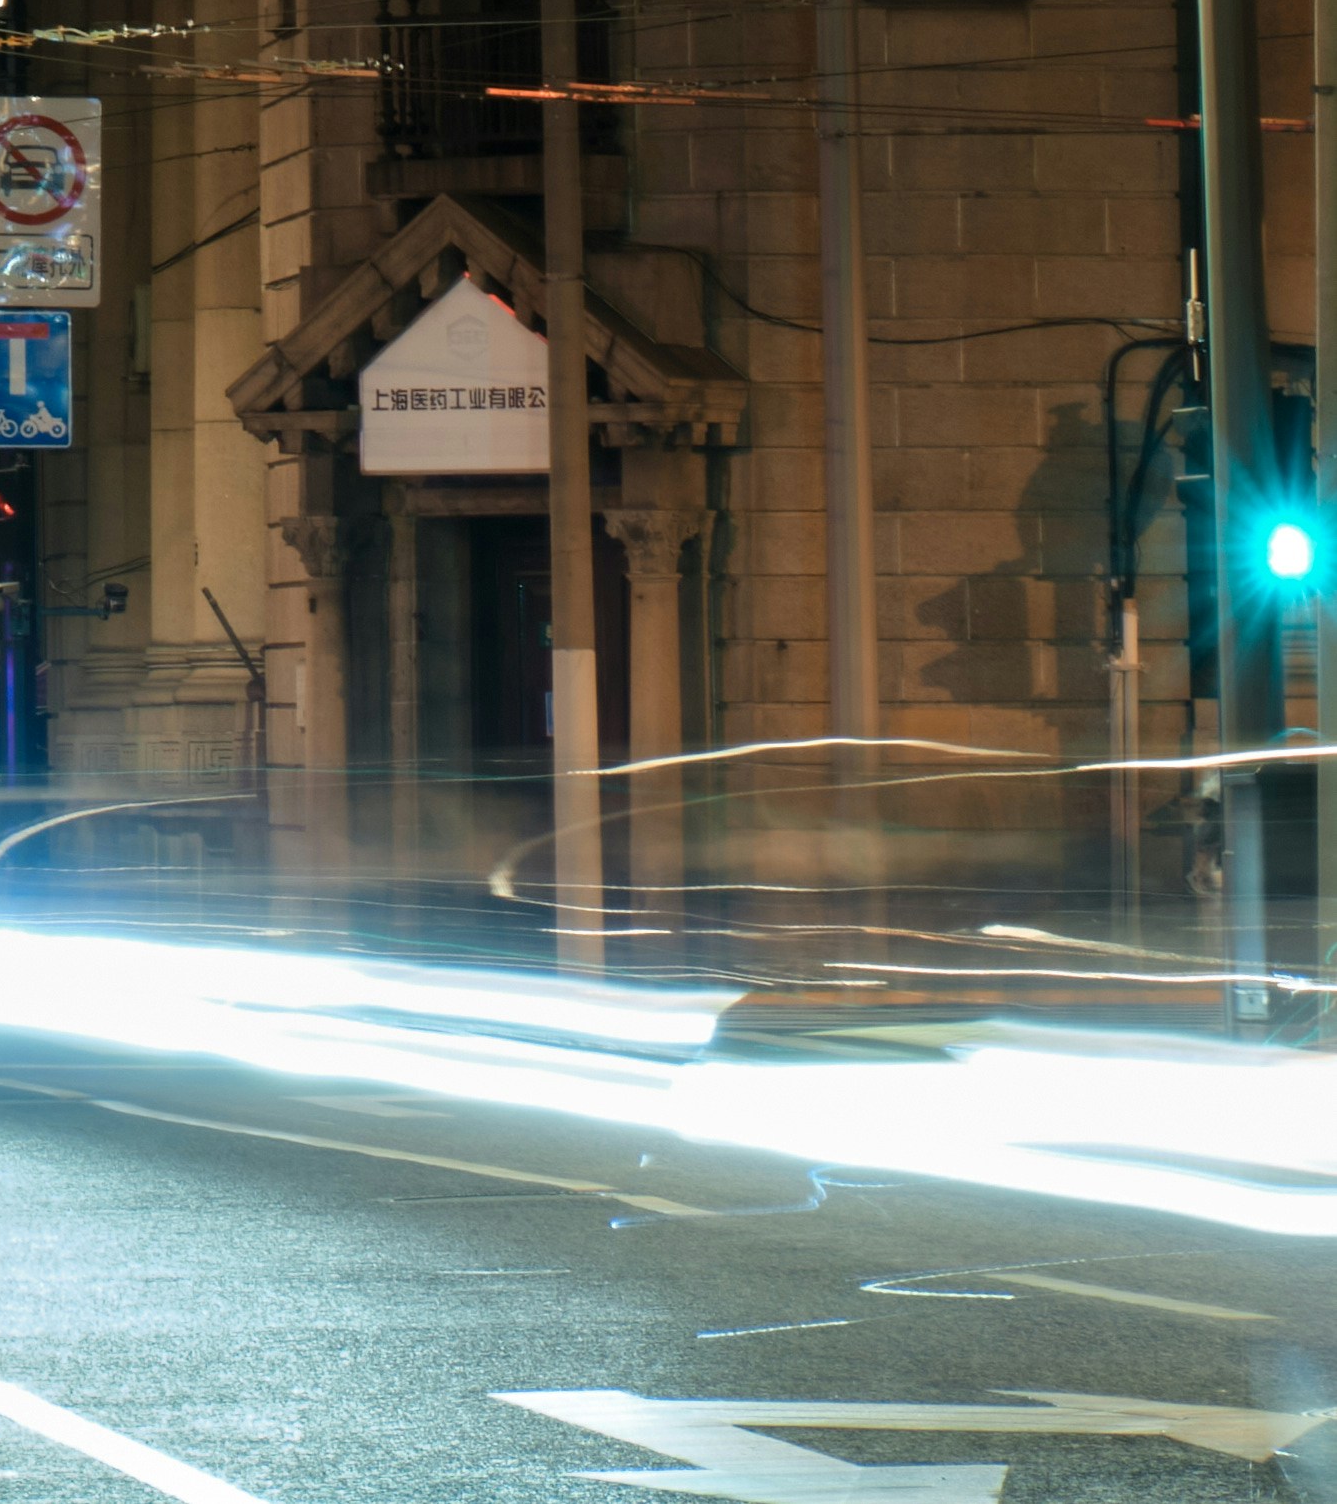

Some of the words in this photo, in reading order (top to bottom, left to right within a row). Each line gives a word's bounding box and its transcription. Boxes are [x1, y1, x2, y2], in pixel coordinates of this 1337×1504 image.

[371, 387, 546, 411] 上海医药工业有限公
